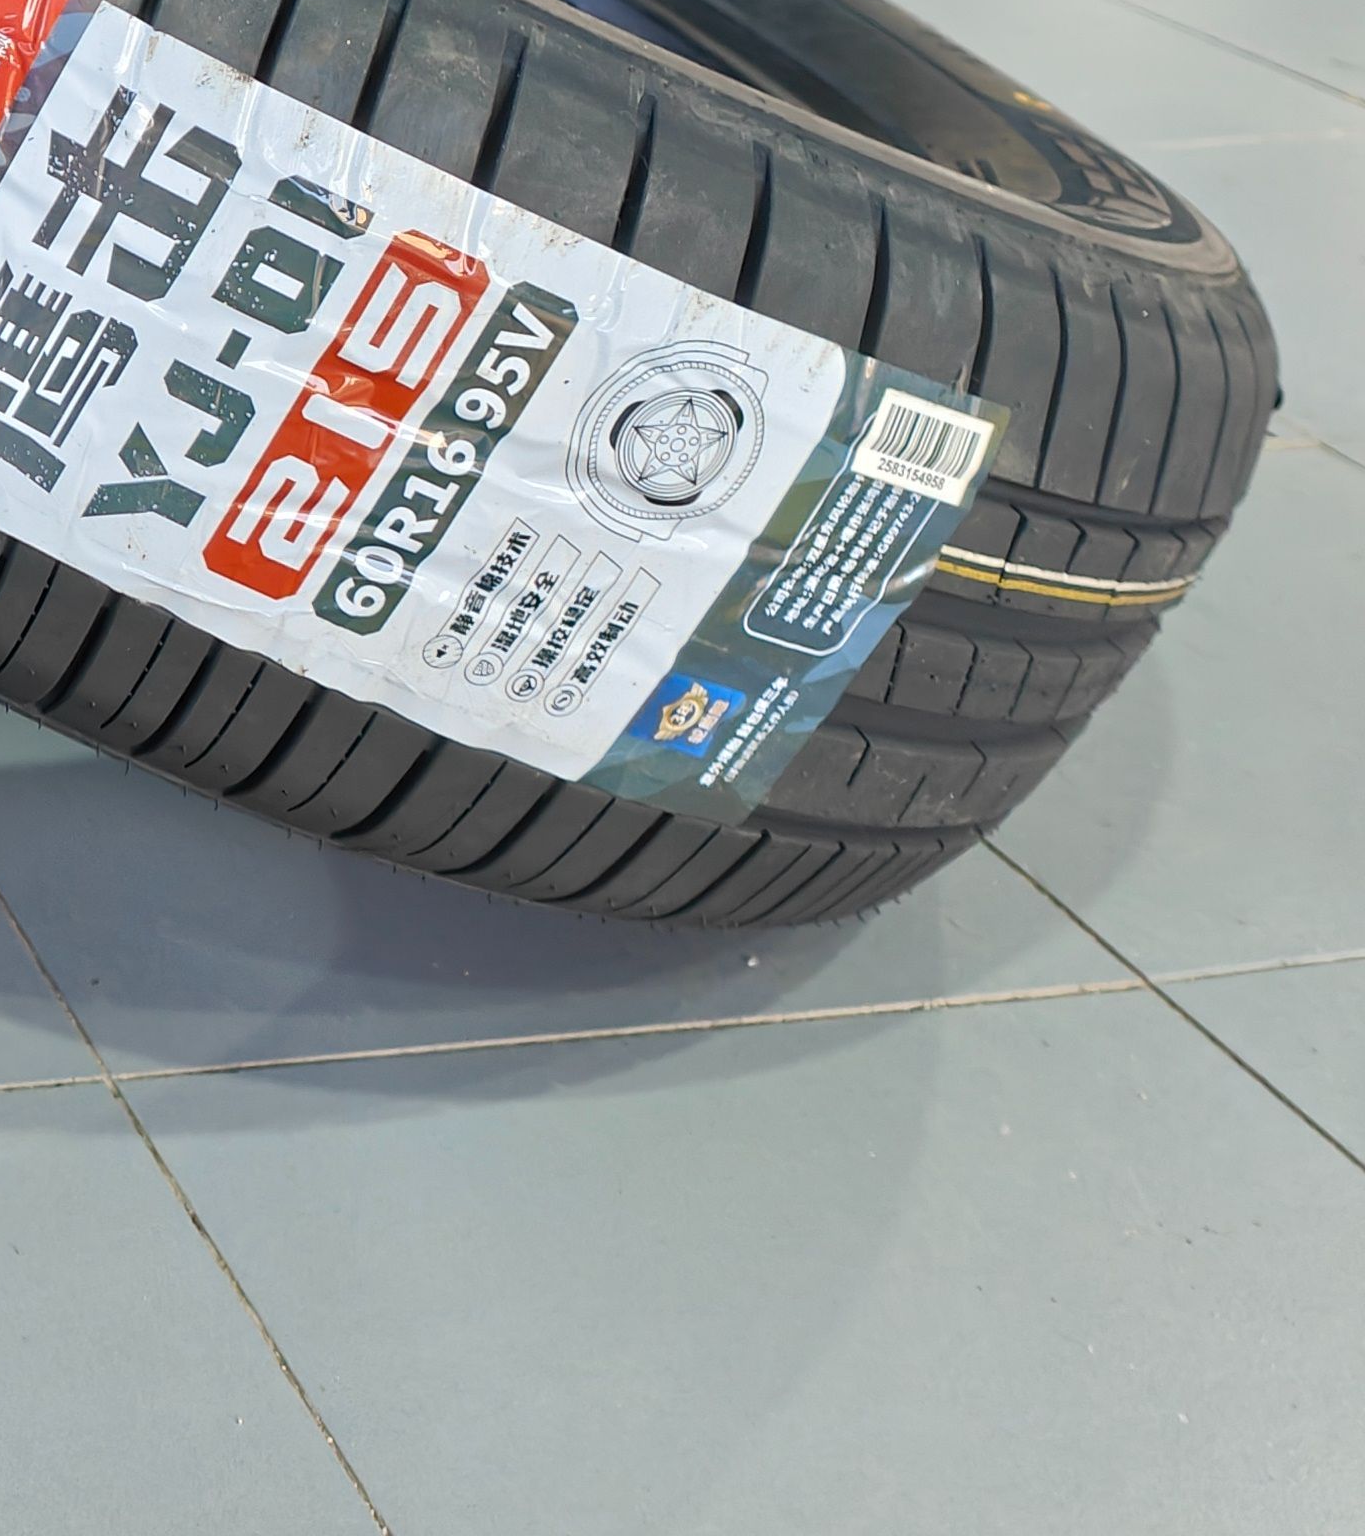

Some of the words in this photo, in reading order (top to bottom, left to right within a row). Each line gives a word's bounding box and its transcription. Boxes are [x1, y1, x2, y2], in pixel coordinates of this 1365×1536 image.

[226, 265, 466, 572] 215
[334, 436, 478, 622] 60R16
[457, 302, 550, 430] 95V
[878, 457, 944, 489] 2583154958
[450, 526, 531, 638] 静音棉技术
[492, 565, 560, 654] 湿地安全
[532, 582, 599, 671] 操控稳定
[572, 597, 639, 685] 高效制动
